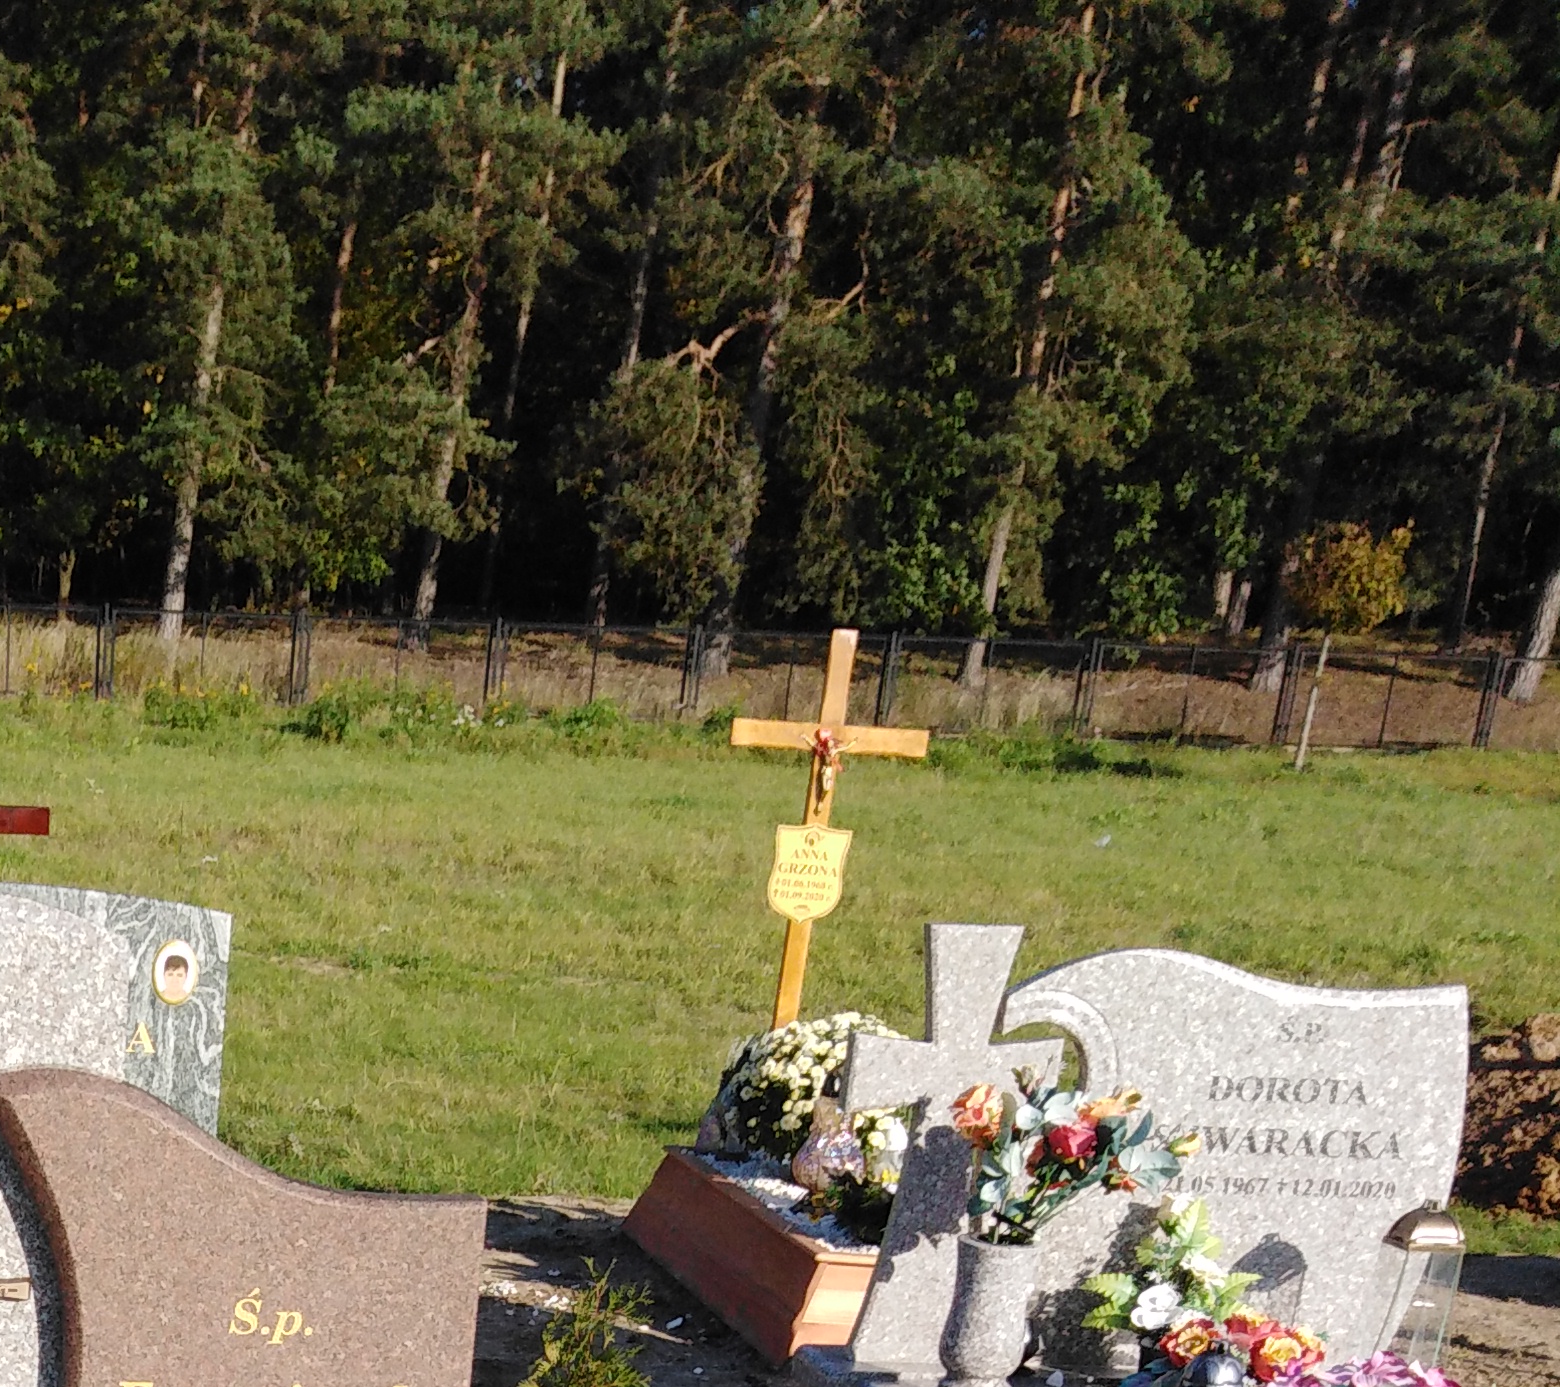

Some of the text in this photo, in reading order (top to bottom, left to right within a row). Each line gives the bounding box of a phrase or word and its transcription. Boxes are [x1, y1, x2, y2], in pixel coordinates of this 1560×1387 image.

[791, 848, 828, 861] ANNA
[778, 862, 838, 878] GRZONA
[1207, 1074, 1368, 1106] DOROTA
[1292, 1178, 1396, 1200] 12.01.2020
[228, 1288, 315, 1345] Ś.p.
